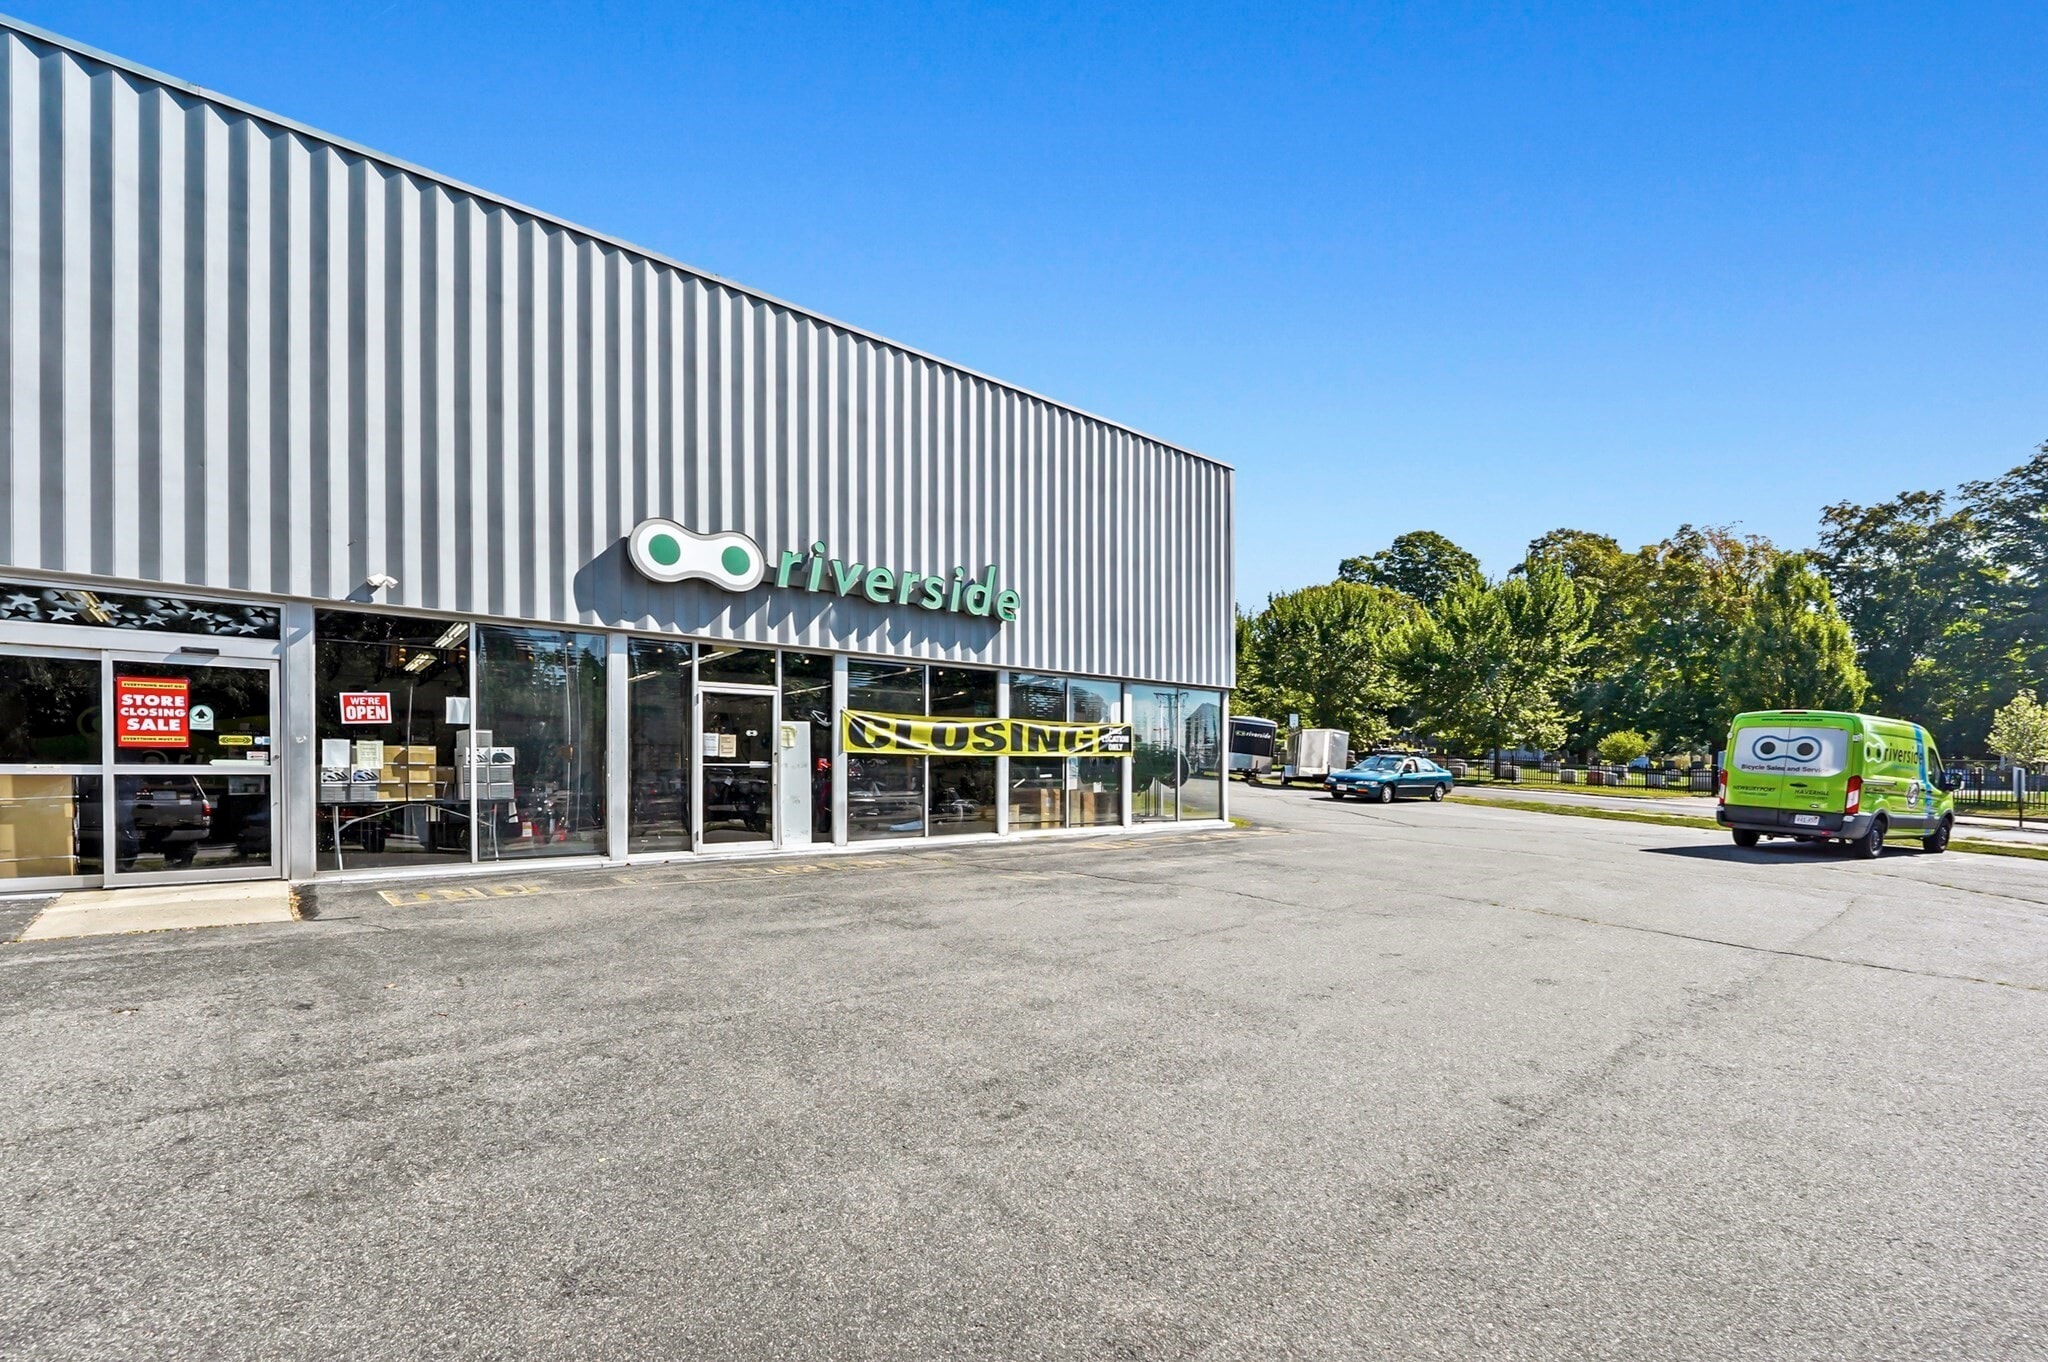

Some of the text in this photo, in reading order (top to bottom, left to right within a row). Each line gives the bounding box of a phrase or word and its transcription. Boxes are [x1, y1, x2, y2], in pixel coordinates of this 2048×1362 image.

[775, 540, 1021, 622] riverside
[121, 693, 185, 707] STORE
[350, 696, 381, 705] WE'RE
[120, 707, 186, 717] CLOSING
[345, 705, 387, 720] OPEN
[126, 717, 181, 731] SALE
[848, 715, 1094, 753] CLOSING
[1108, 743, 1123, 751] ONLY
[1741, 763, 1765, 771] Bicycle
